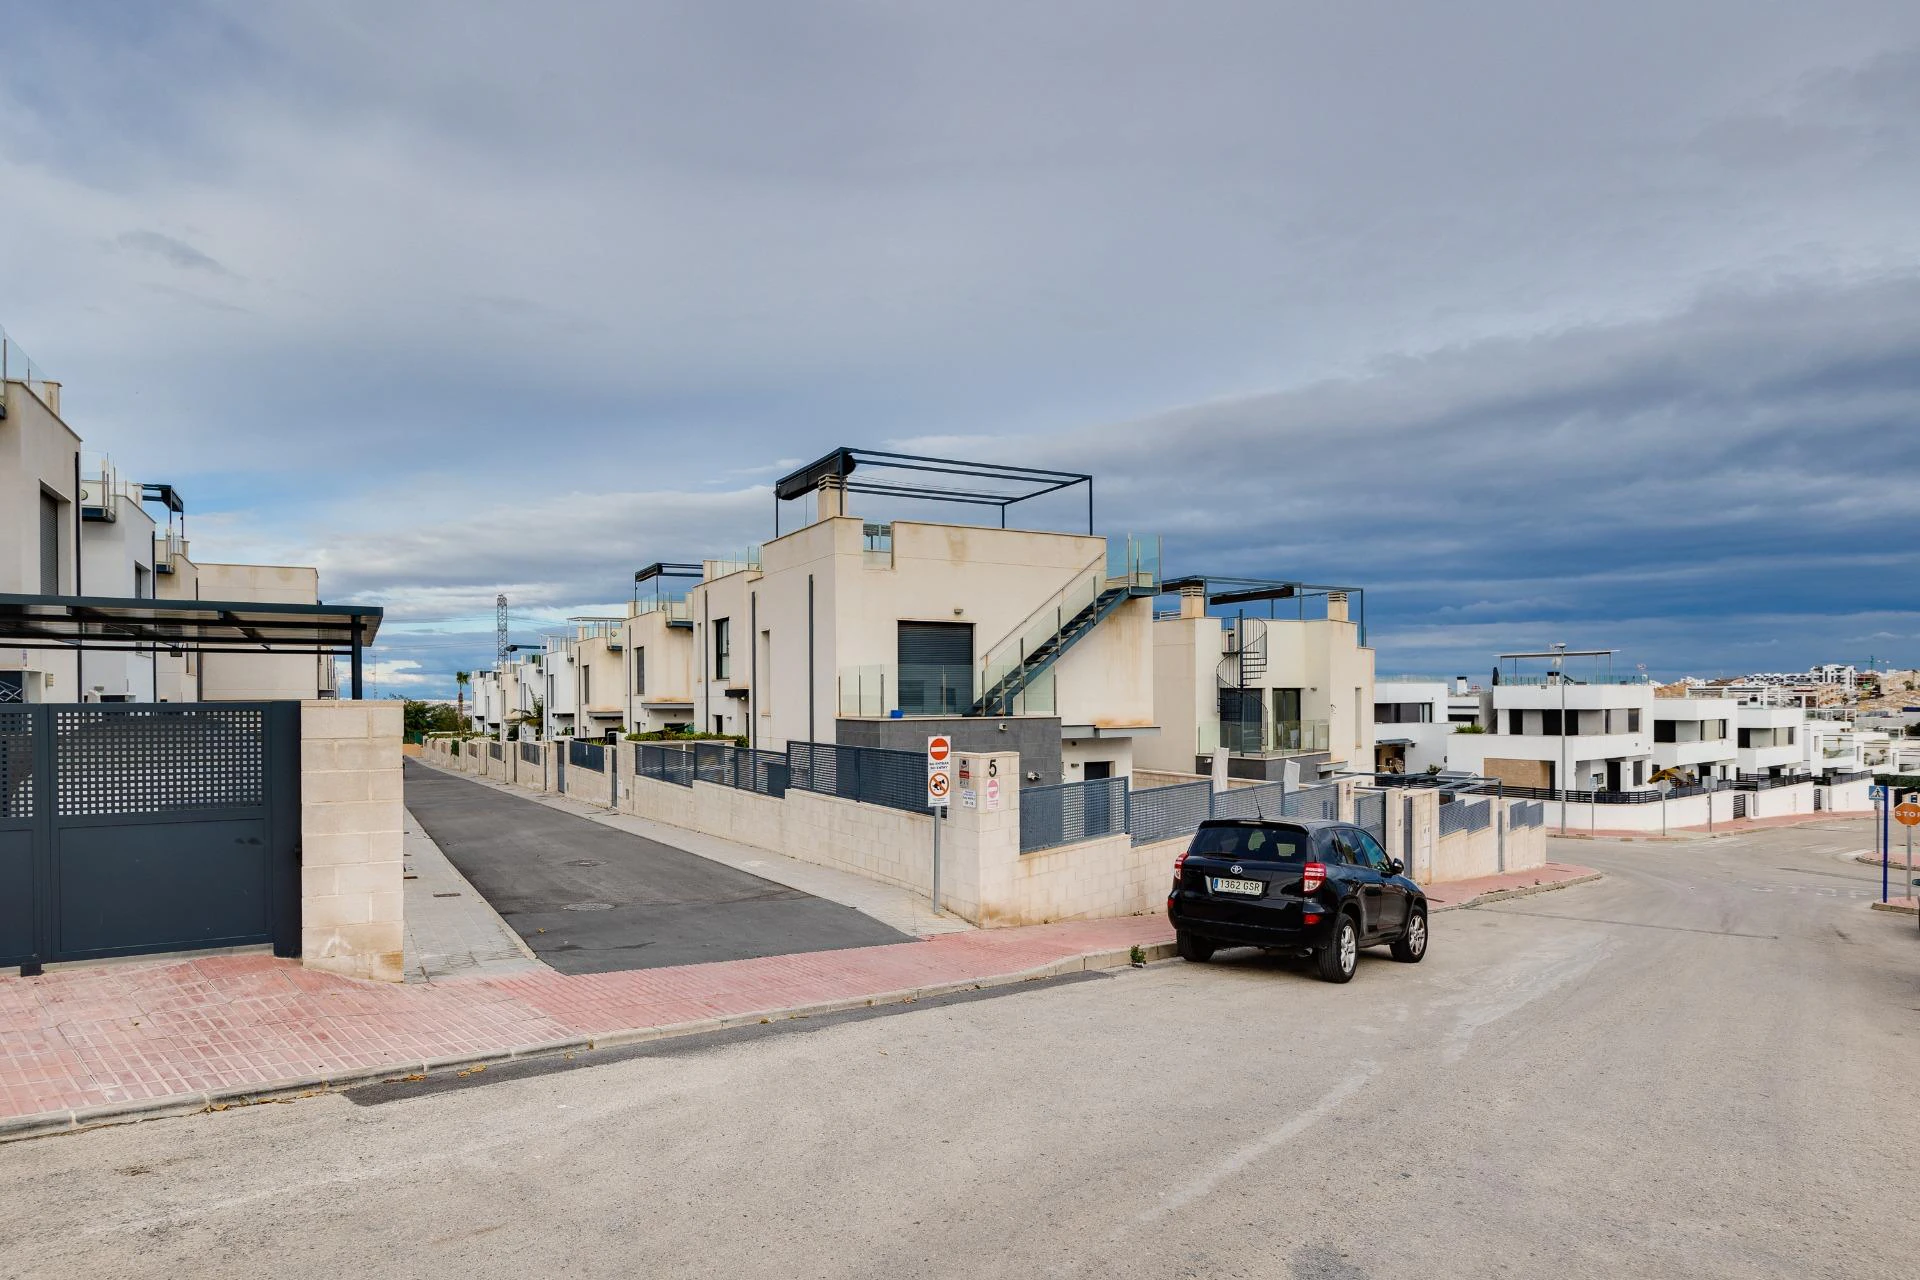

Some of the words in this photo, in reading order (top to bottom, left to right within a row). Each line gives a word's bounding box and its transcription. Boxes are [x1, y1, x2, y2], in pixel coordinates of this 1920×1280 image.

[988, 759, 997, 777] 5
[1220, 880, 1241, 890] 1362
[1243, 881, 1260, 891] GSR
